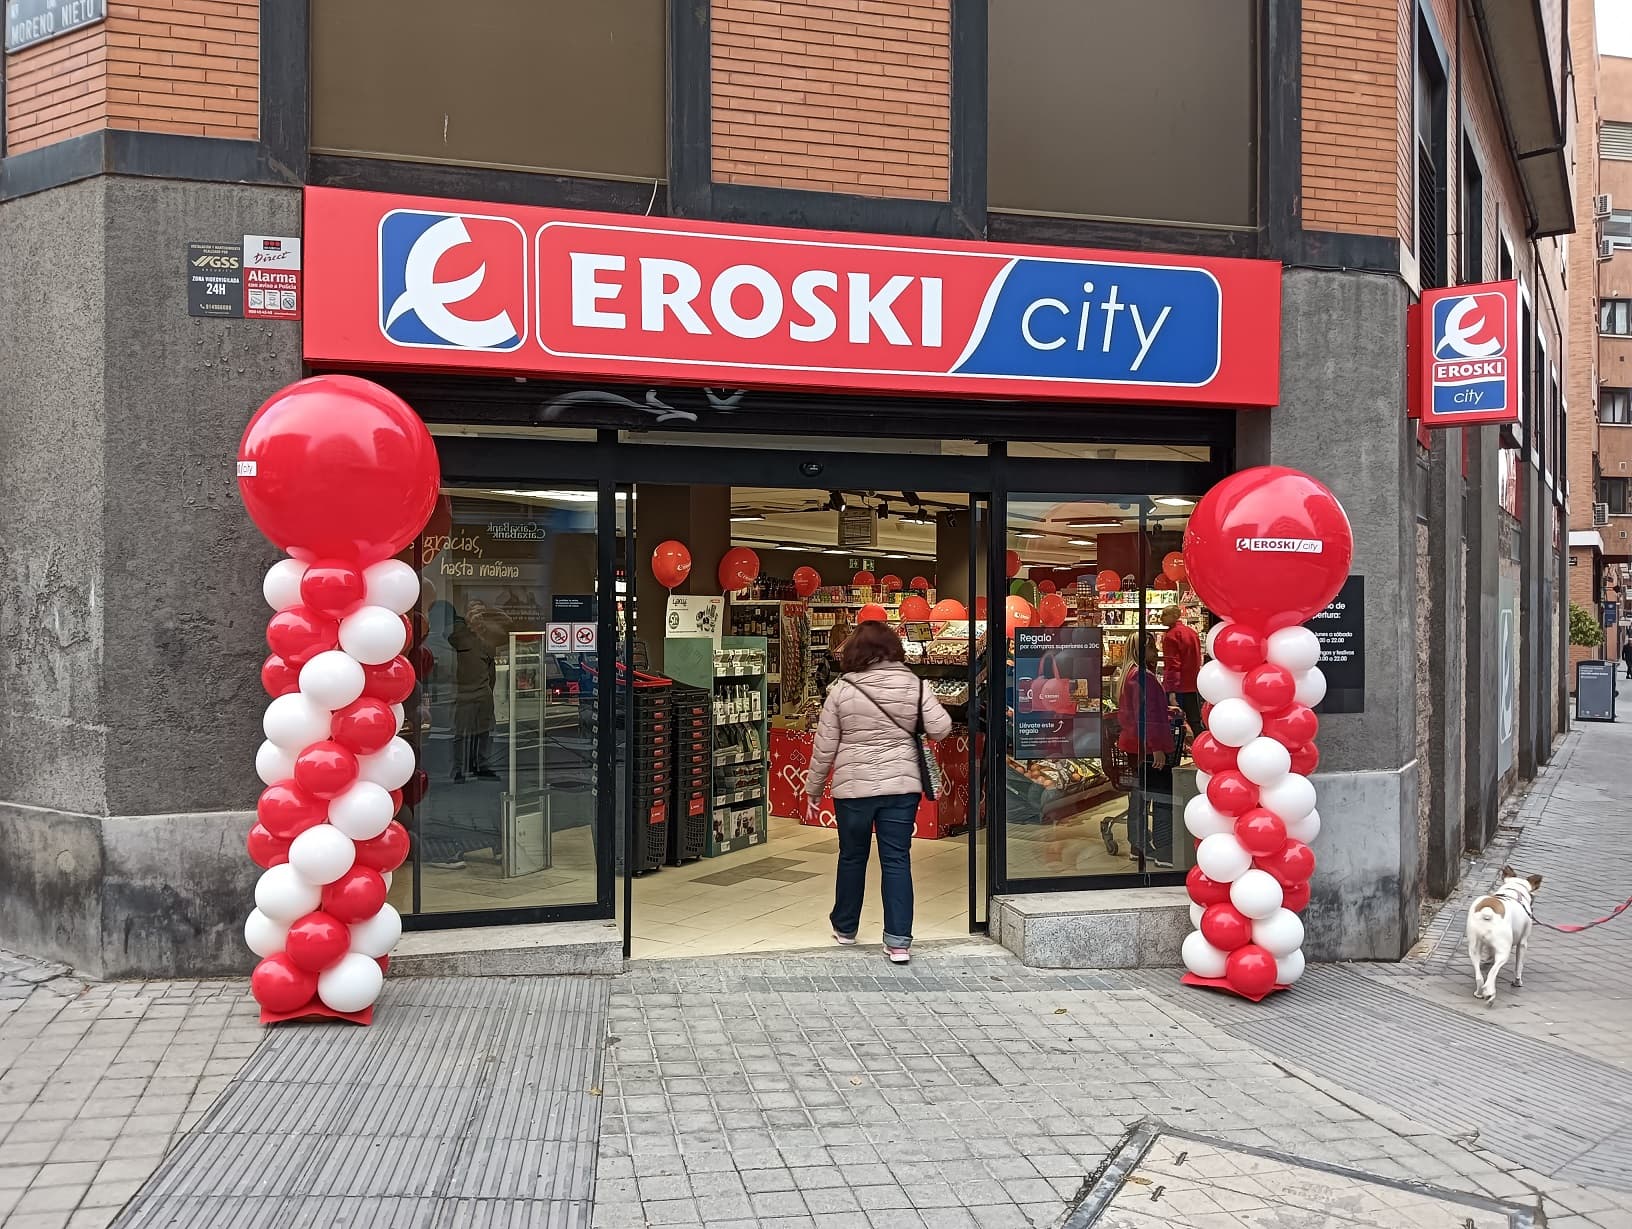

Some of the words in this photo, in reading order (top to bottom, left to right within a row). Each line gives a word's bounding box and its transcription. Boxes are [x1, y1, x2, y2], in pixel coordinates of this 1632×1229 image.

[11, 12, 54, 46] MORENO
[61, 0, 94, 28] NIETO
[209, 256, 240, 269] GSS
[254, 251, 291, 264] Direct
[248, 270, 297, 284] Alarma
[206, 283, 226, 295] 24H
[570, 253, 943, 350] EROSKI
[1022, 282, 1172, 371] city
[1437, 361, 1502, 379] EROSKI
[1454, 389, 1484, 405] city
[422, 529, 483, 565] gracias,
[441, 558, 473, 577] hasta
[480, 561, 519, 578] mañana
[1335, 602, 1346, 610] de
[1019, 728, 1039, 736] regalo
